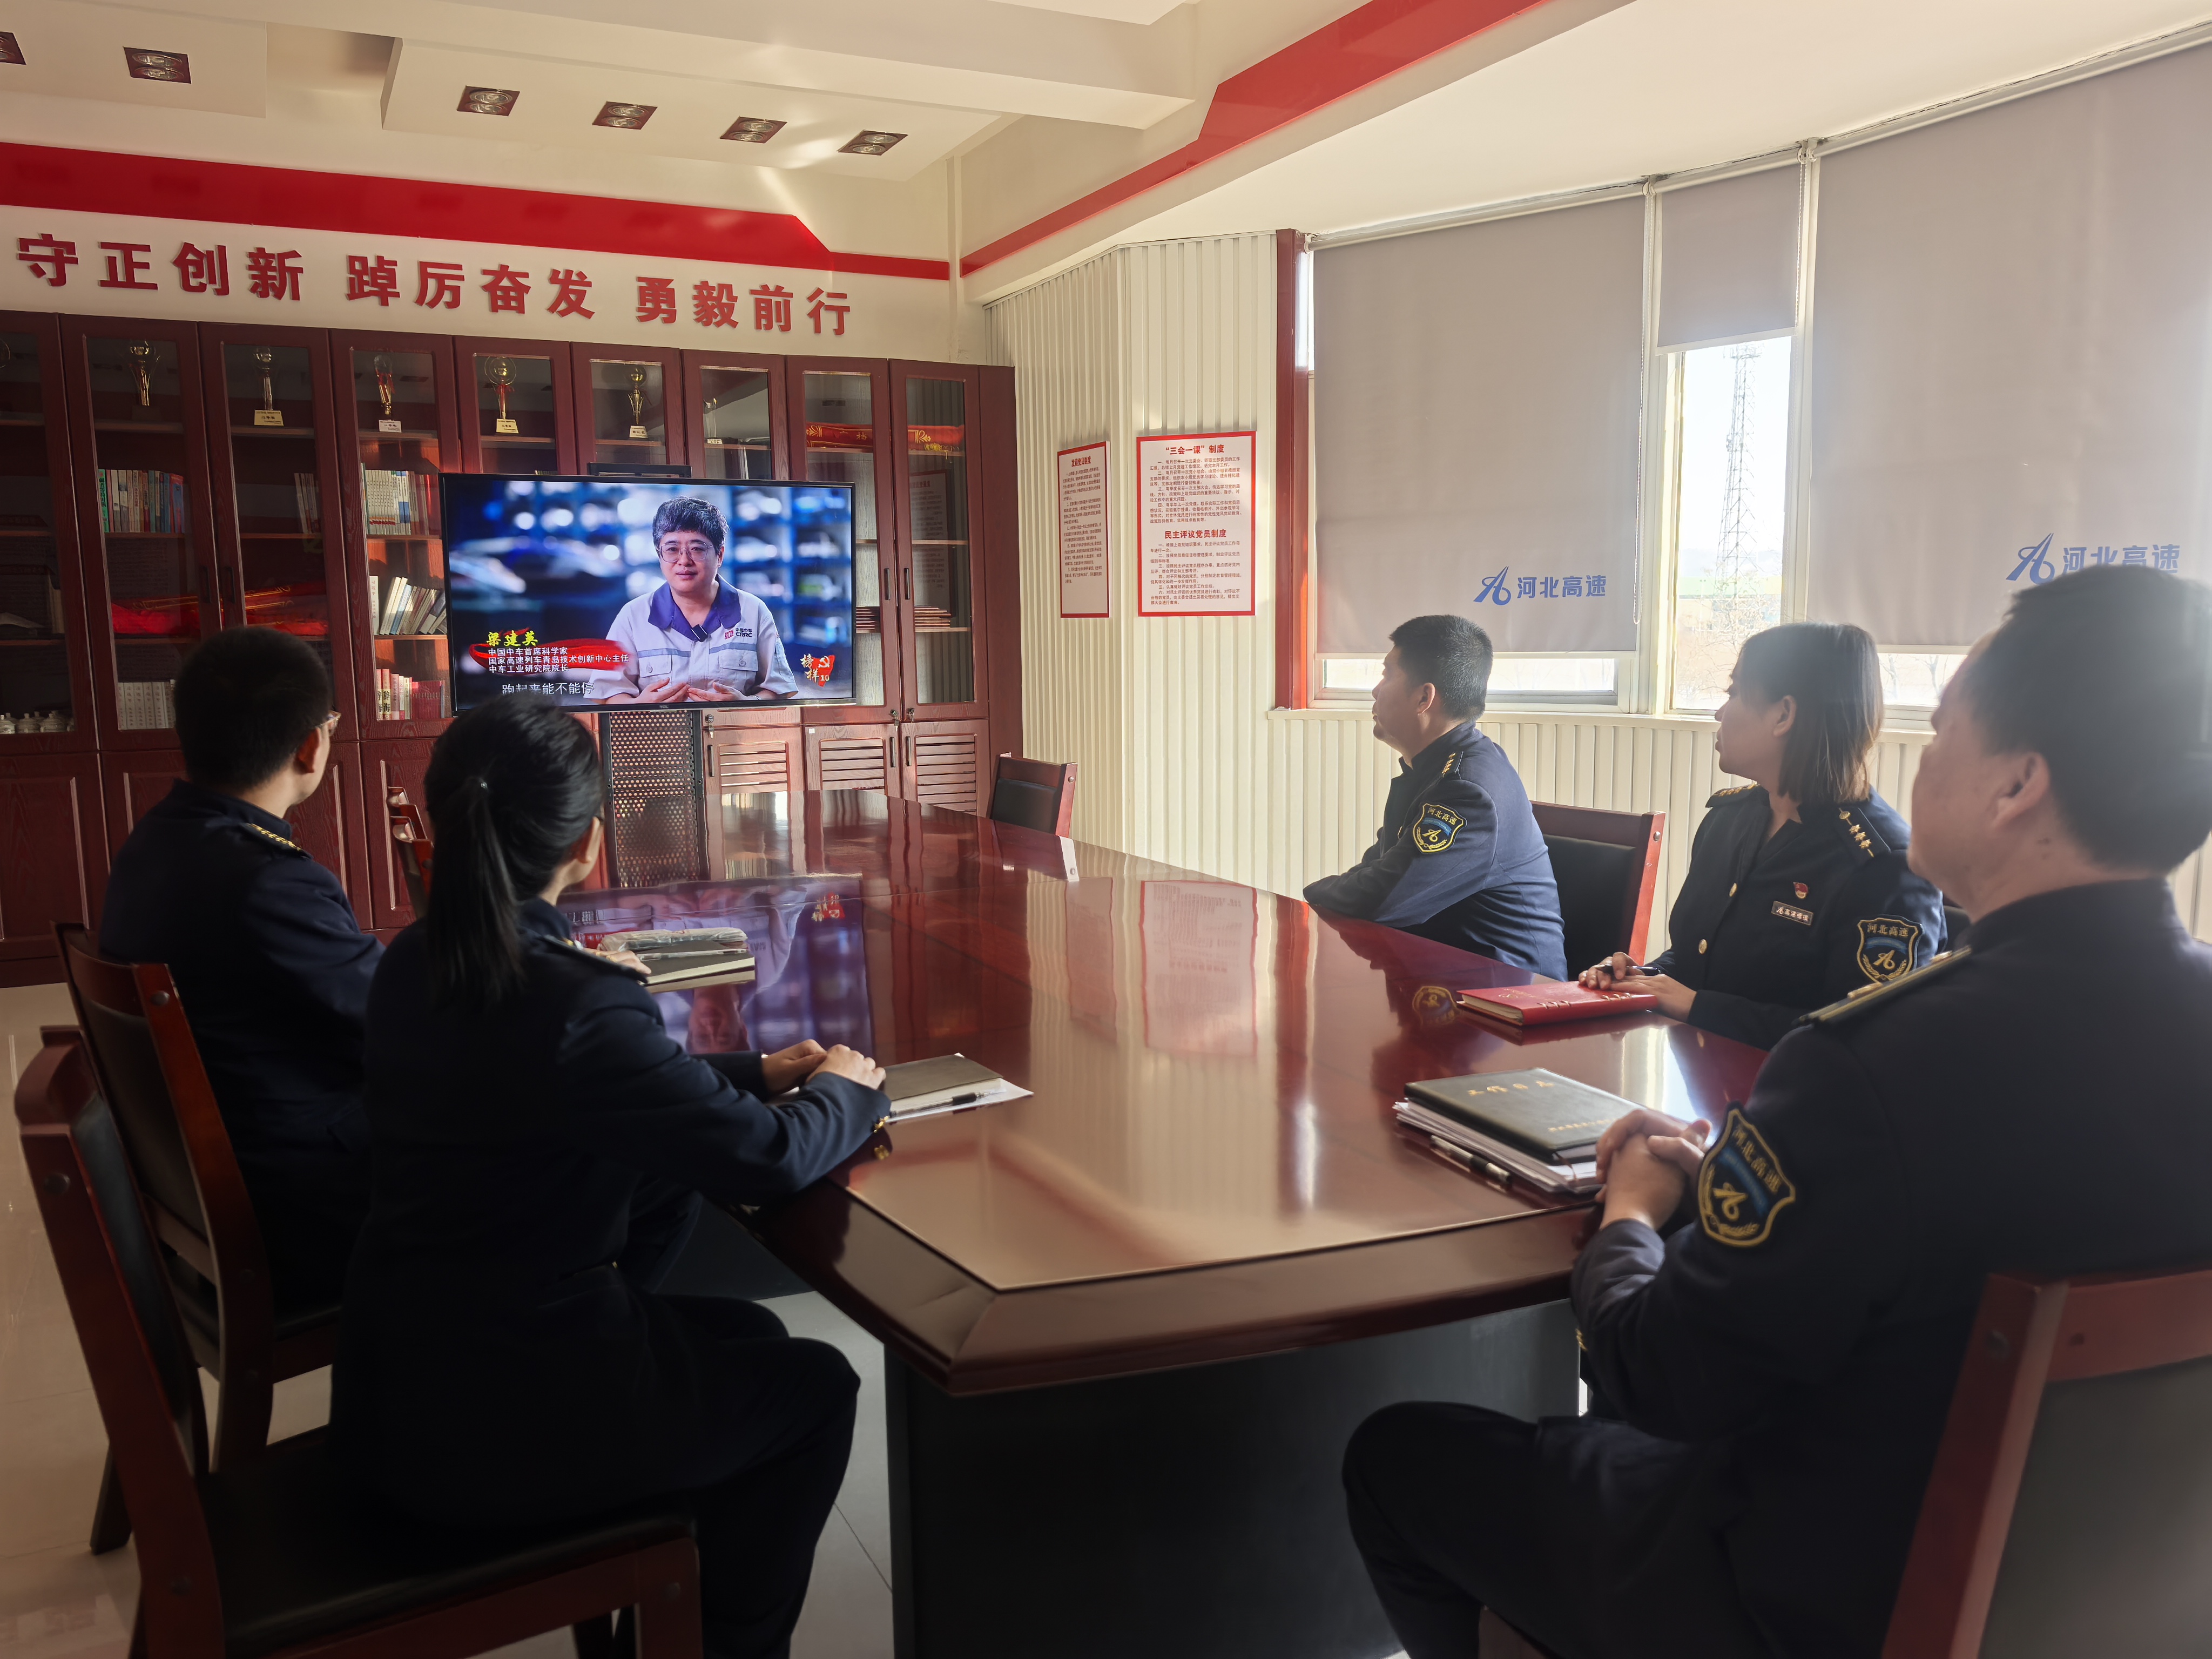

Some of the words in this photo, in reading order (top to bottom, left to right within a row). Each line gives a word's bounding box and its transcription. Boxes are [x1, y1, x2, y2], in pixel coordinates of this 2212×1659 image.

[17, 233, 304, 301] 守正创新
[346, 254, 595, 320] 踔厉奋发
[636, 275, 851, 335] 勇毅前行
[1165, 445, 1205, 455] “三会一课”
[1209, 444, 1225, 453] 制度
[1165, 529, 1227, 539] 民主评议党员制度
[2062, 544, 2181, 575] 河北高速
[1517, 575, 1607, 599] 河北高速
[486, 630, 538, 646] 梁建英
[488, 646, 568, 656] 中国中车首席科学家
[488, 654, 630, 665] 国家高速列车青岛技术创新中心主任
[489, 664, 569, 673] 中车工业研究院院长
[1427, 807, 1457, 825] 河北高速
[1867, 923, 1908, 937] 河北高速
